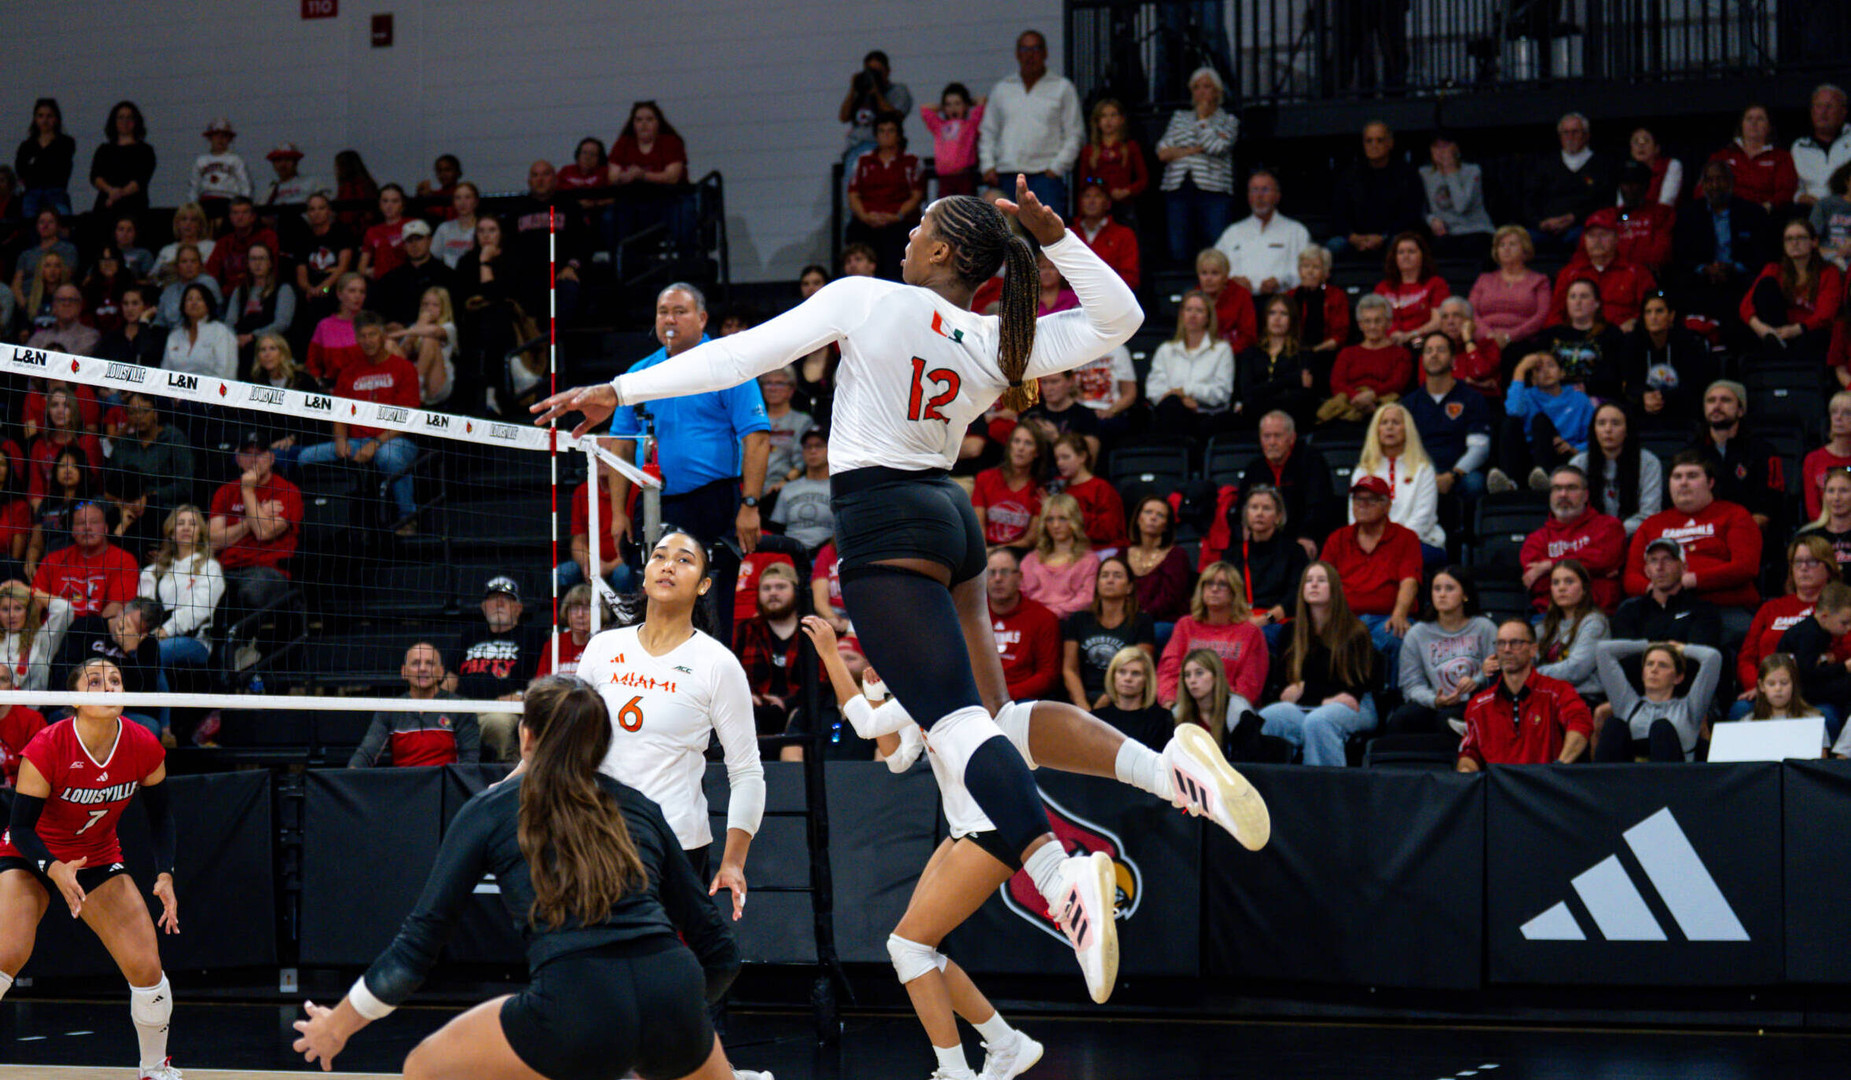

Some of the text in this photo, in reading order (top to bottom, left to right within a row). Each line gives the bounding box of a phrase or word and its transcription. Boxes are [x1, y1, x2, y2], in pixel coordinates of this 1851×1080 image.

[13, 347, 47, 366] L&N
[105, 362, 146, 383] LOUISVILLE
[168, 373, 198, 390] L&N
[249, 385, 285, 405] LOUISVILLE
[907, 355, 961, 425] 12
[304, 394, 331, 411] L&N
[426, 413, 449, 428] L&N
[671, 665, 693, 675] ACC
[610, 672, 676, 693] MIAMI
[618, 695, 644, 732] 6
[75, 808, 109, 835] 7
